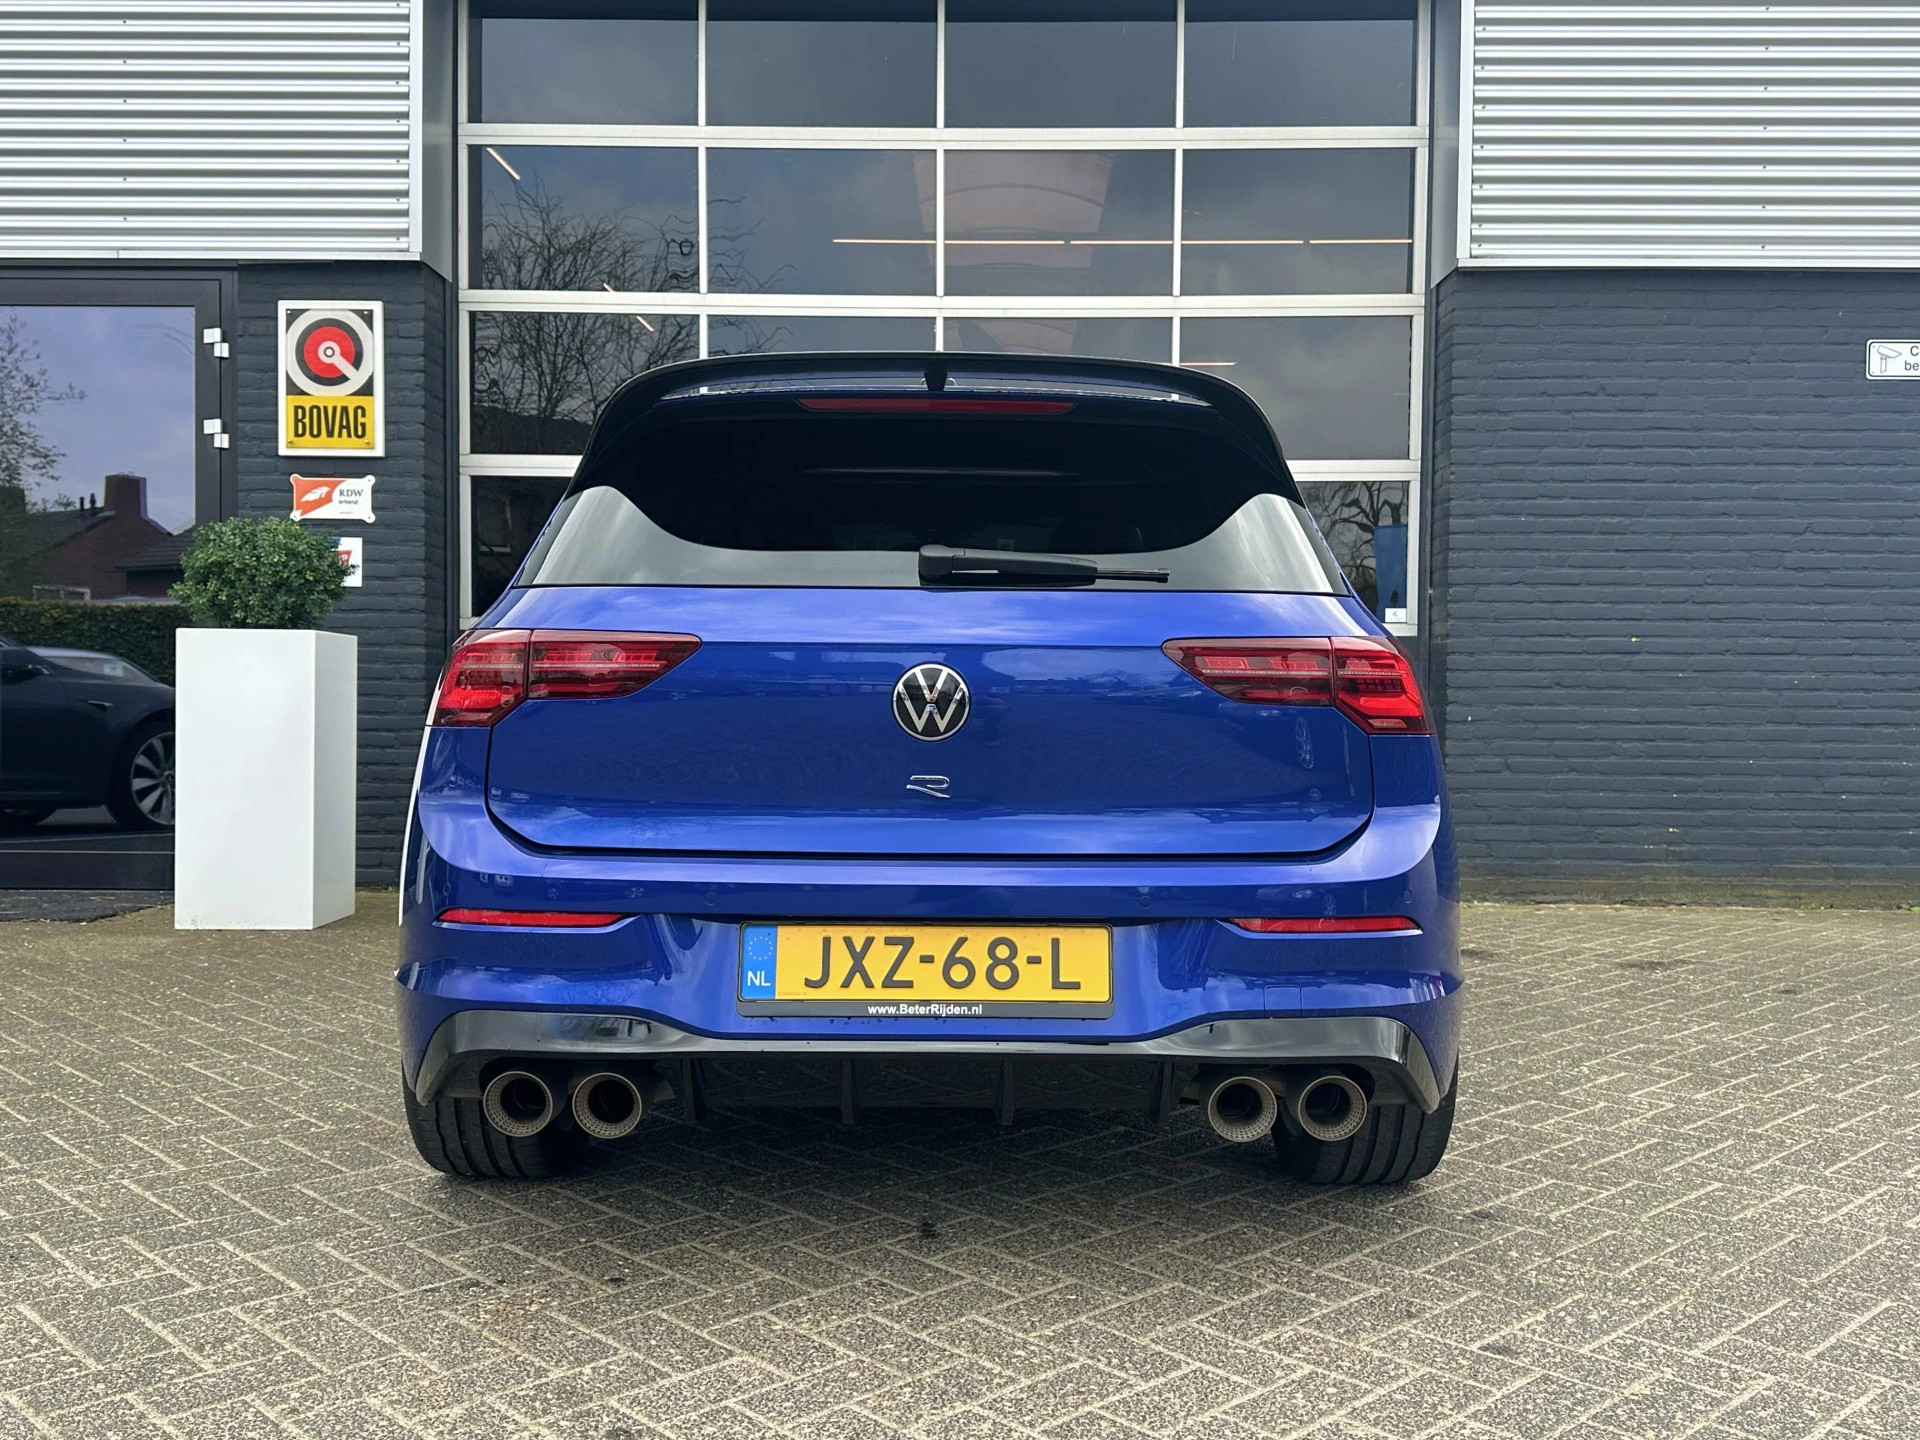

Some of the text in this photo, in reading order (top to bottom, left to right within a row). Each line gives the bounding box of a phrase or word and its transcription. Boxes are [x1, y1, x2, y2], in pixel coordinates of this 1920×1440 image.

[293, 405, 367, 439] BOVAG
[339, 489, 363, 497] RDW
[804, 936, 1081, 990] JXZ-68-L
[747, 970, 772, 987] NL
[867, 1003, 983, 1017] www.BeterRijden.nl
